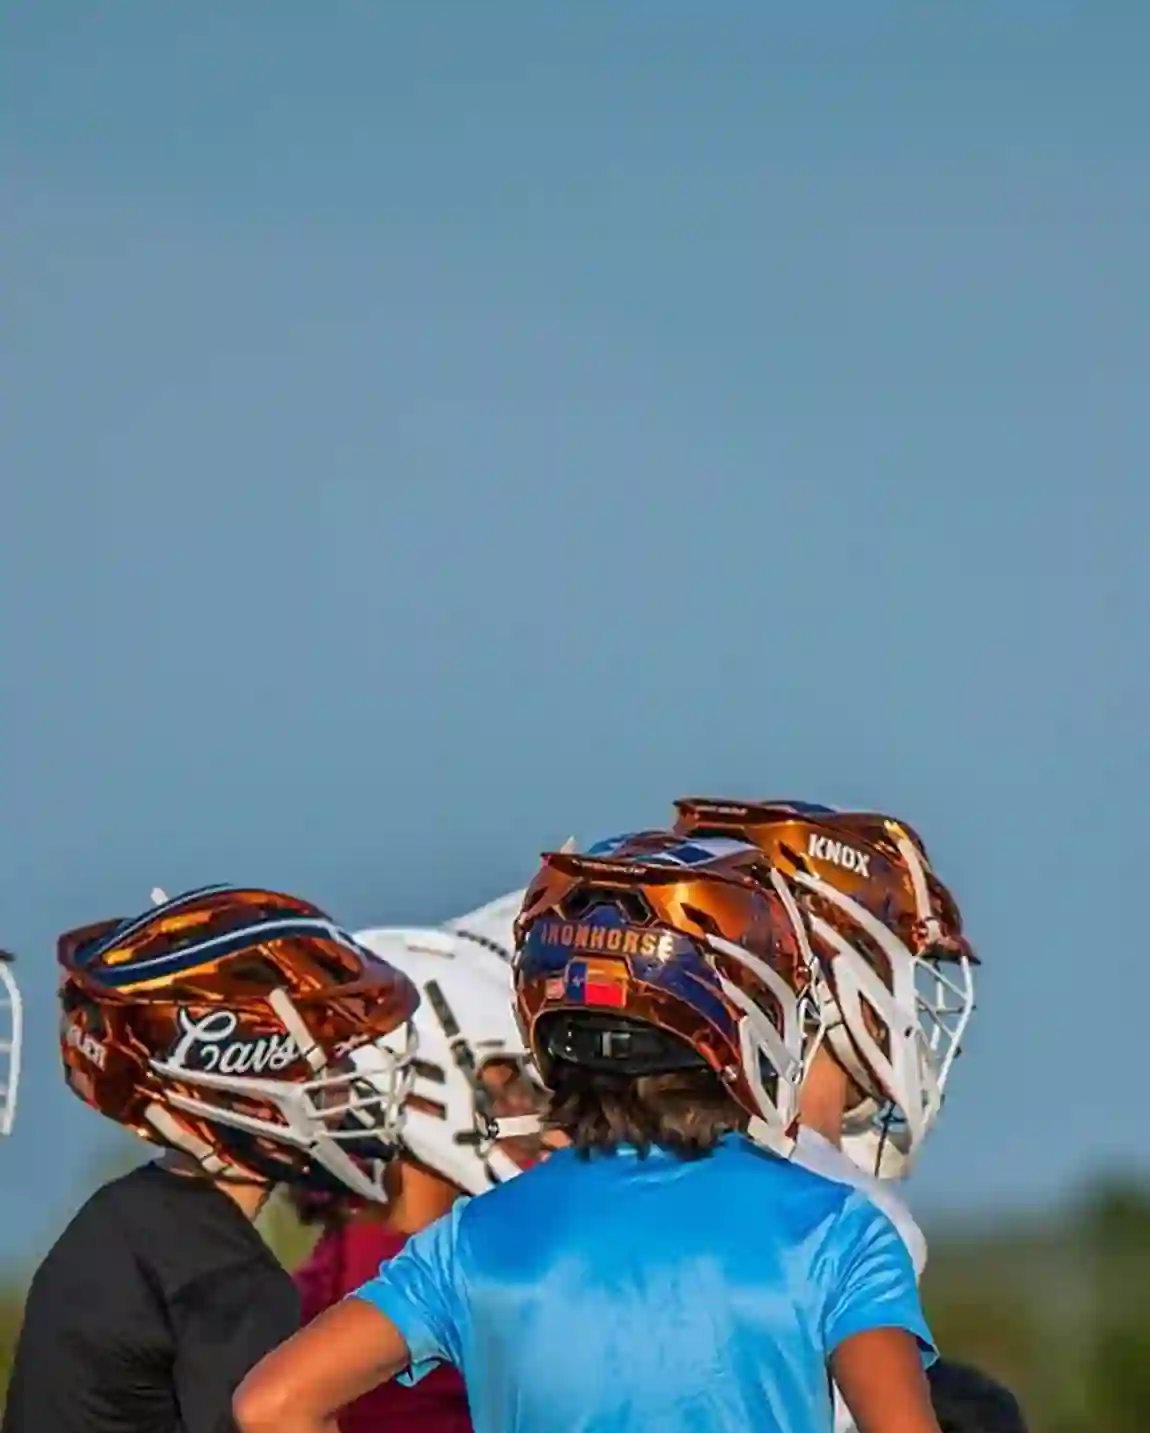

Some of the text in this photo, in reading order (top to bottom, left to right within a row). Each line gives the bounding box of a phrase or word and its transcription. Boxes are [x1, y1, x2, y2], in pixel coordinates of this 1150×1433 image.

[807, 832, 871, 878] KNOX
[541, 921, 674, 963] IRONHORSE
[167, 1007, 301, 1075] Cavs
